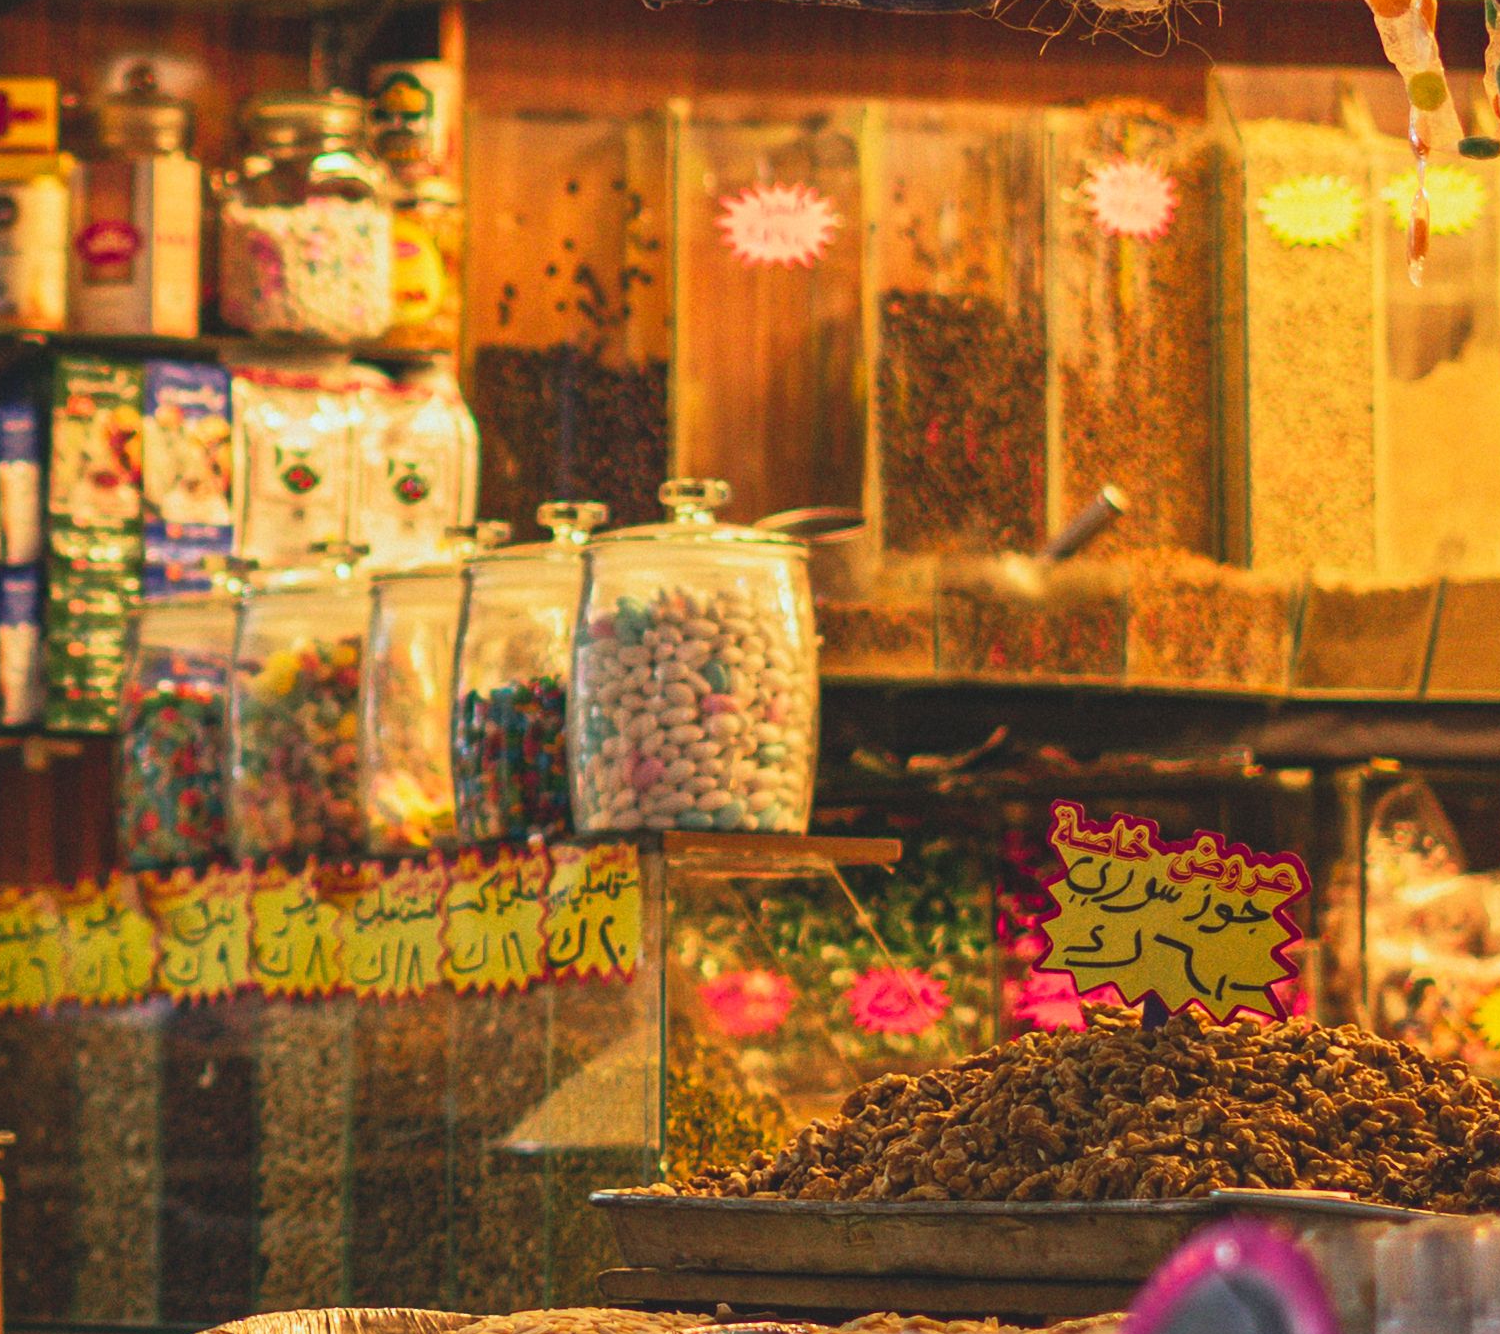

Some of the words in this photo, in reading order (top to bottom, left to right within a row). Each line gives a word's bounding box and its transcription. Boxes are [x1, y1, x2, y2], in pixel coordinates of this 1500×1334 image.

[1057, 809, 1150, 861] خاصة
[1167, 842, 1294, 897] عروض
[1183, 883, 1271, 935] جوز
